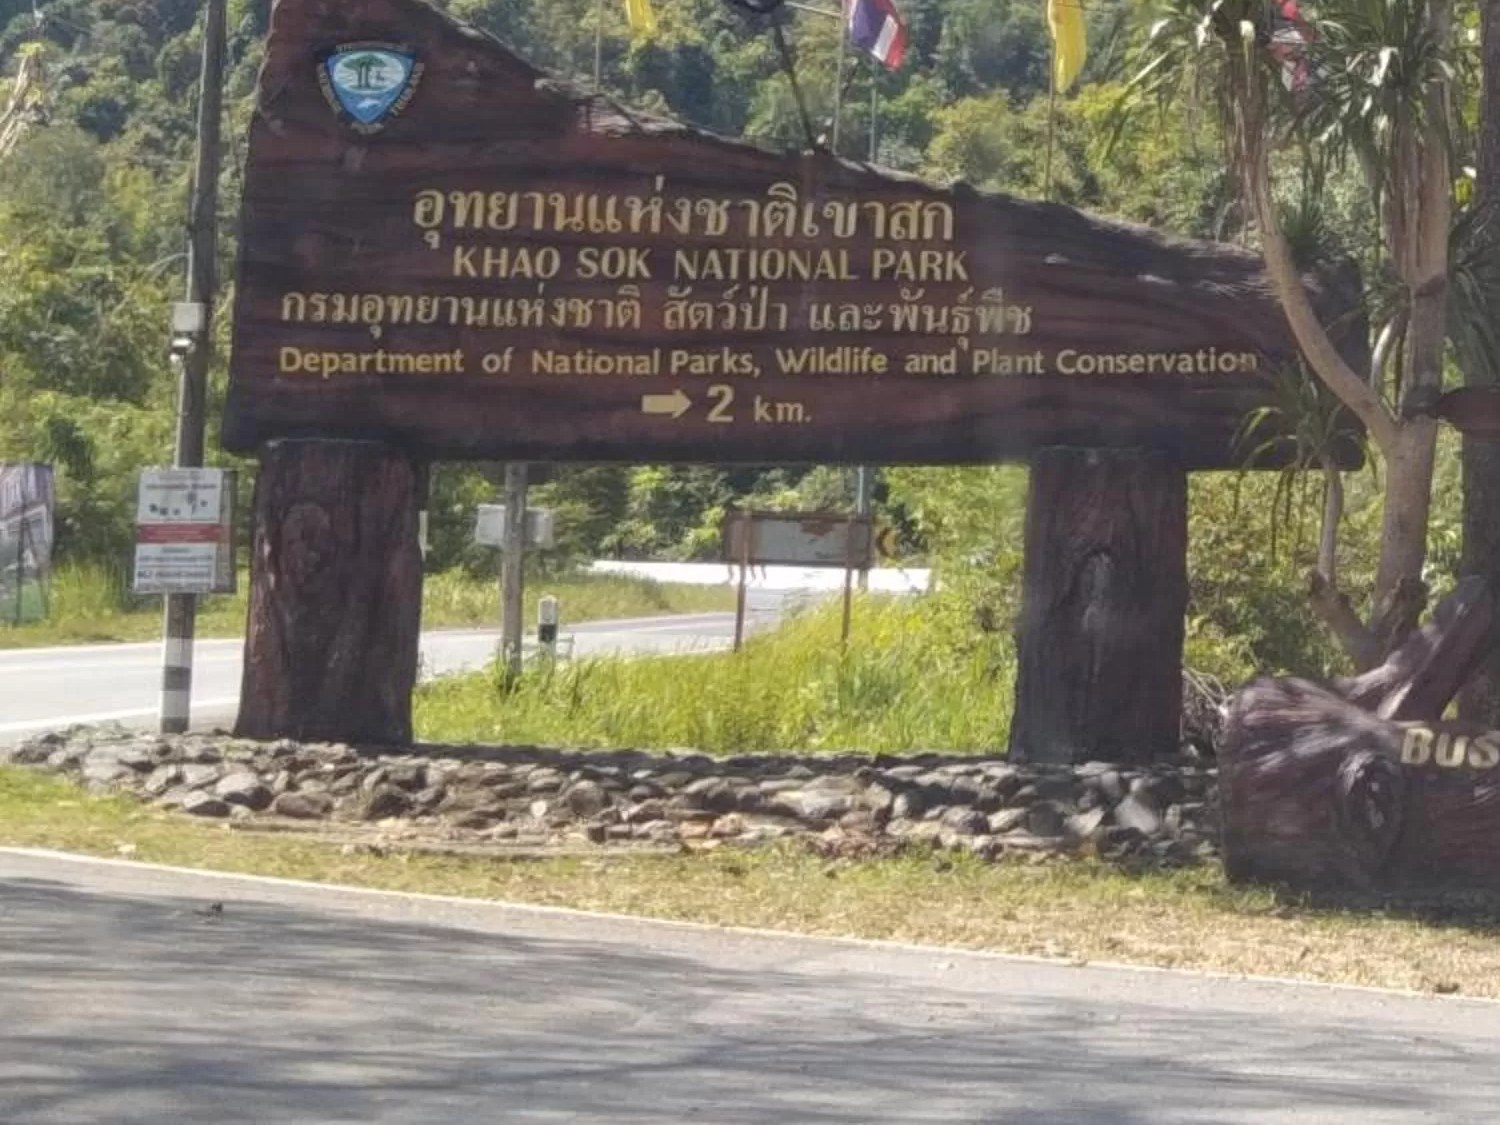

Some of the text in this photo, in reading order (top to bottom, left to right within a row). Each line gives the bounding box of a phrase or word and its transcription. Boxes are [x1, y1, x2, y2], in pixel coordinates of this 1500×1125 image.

[453, 246, 969, 282] KHAO SOK NATIONAL PARK
[281, 283, 642, 339] กรมอุทยานแห่งชาติ
[663, 285, 788, 332] สัตว์ป่า
[280, 345, 1258, 378] Department of National Parks, Wildlife and Plant Conservation
[705, 384, 812, 423] 2 km.
[1400, 727, 1500, 769] BUS
